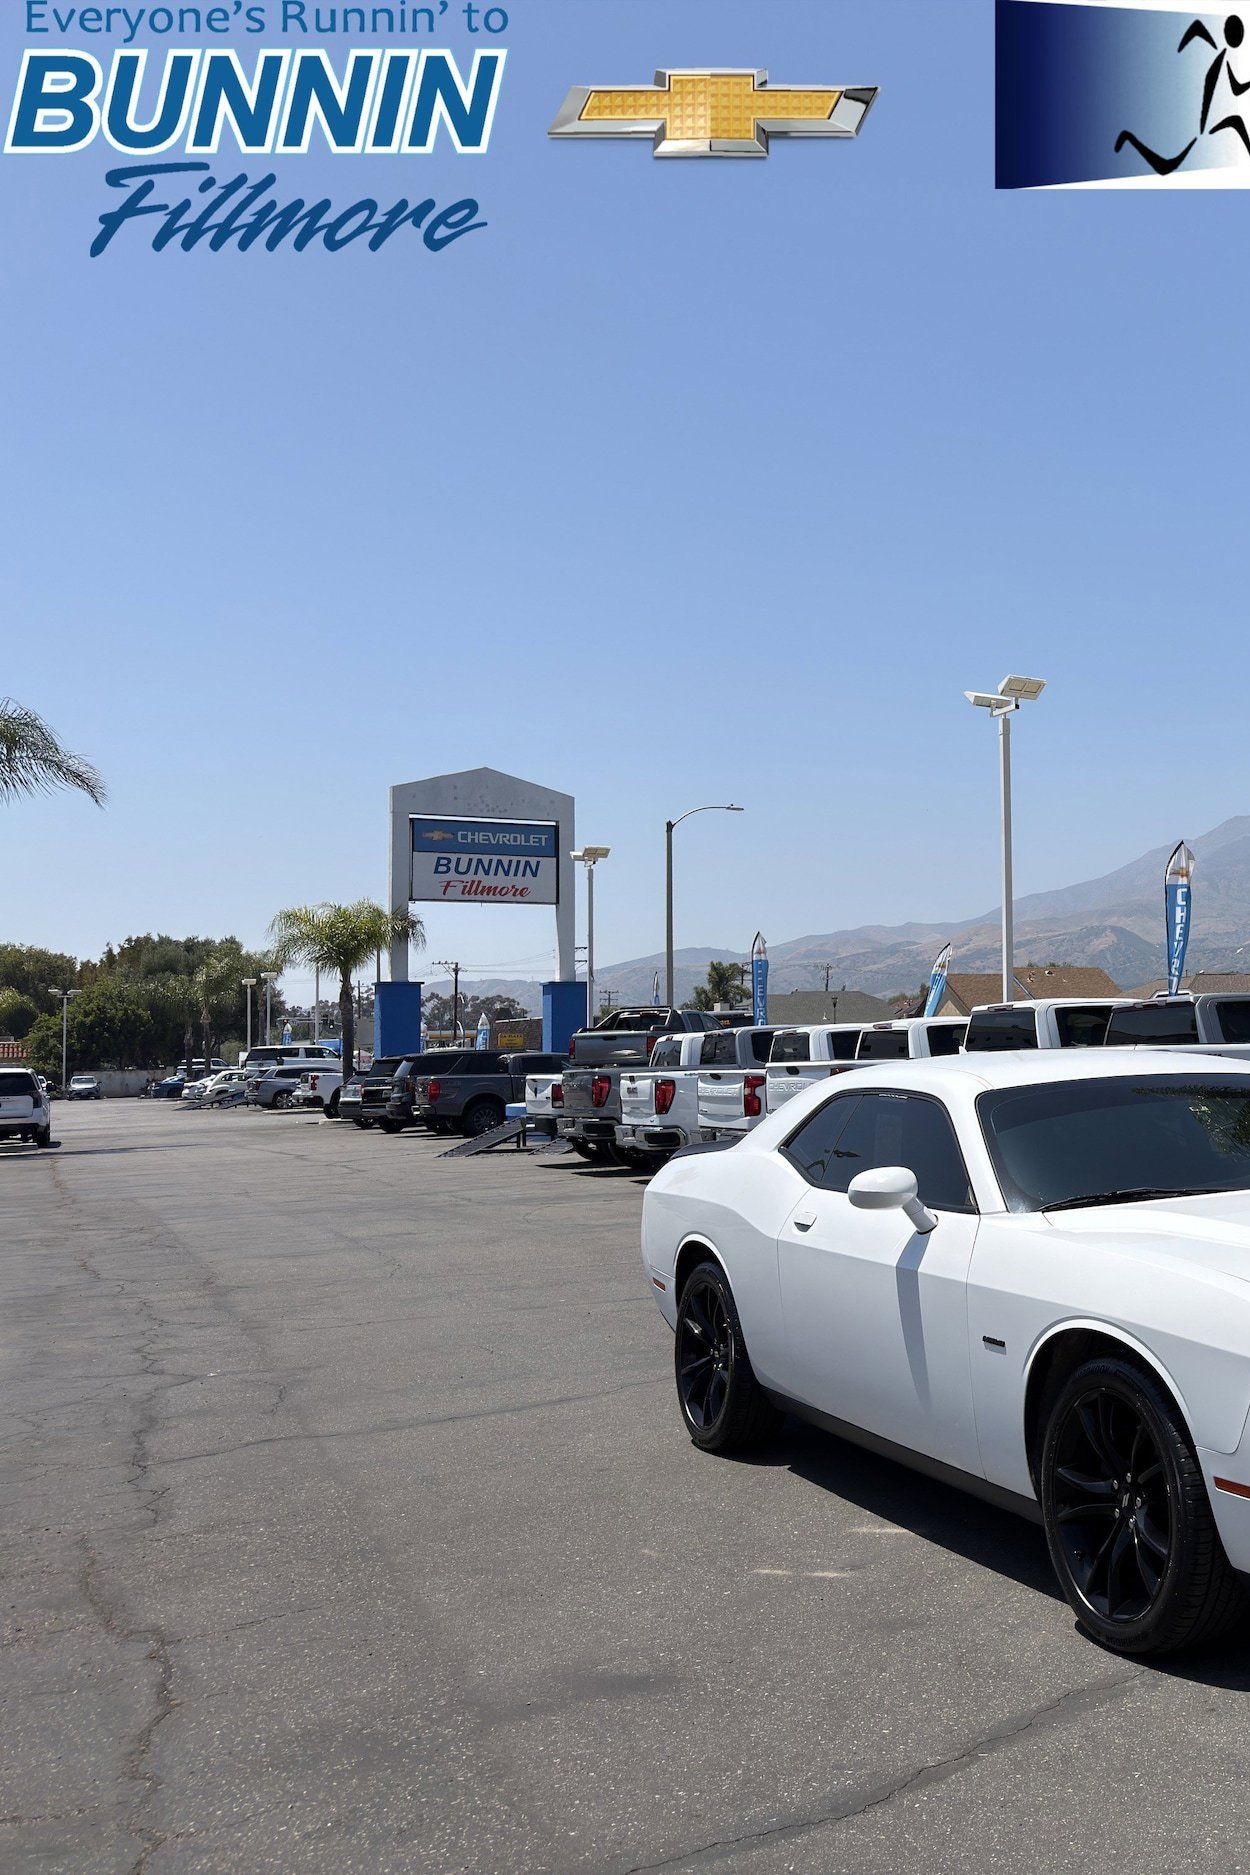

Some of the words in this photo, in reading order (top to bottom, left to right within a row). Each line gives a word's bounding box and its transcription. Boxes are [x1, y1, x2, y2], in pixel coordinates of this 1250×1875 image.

[457, 831, 549, 847] CHEVROLET
[433, 856, 541, 878] BUNNIN
[439, 879, 532, 898] Fillmore
